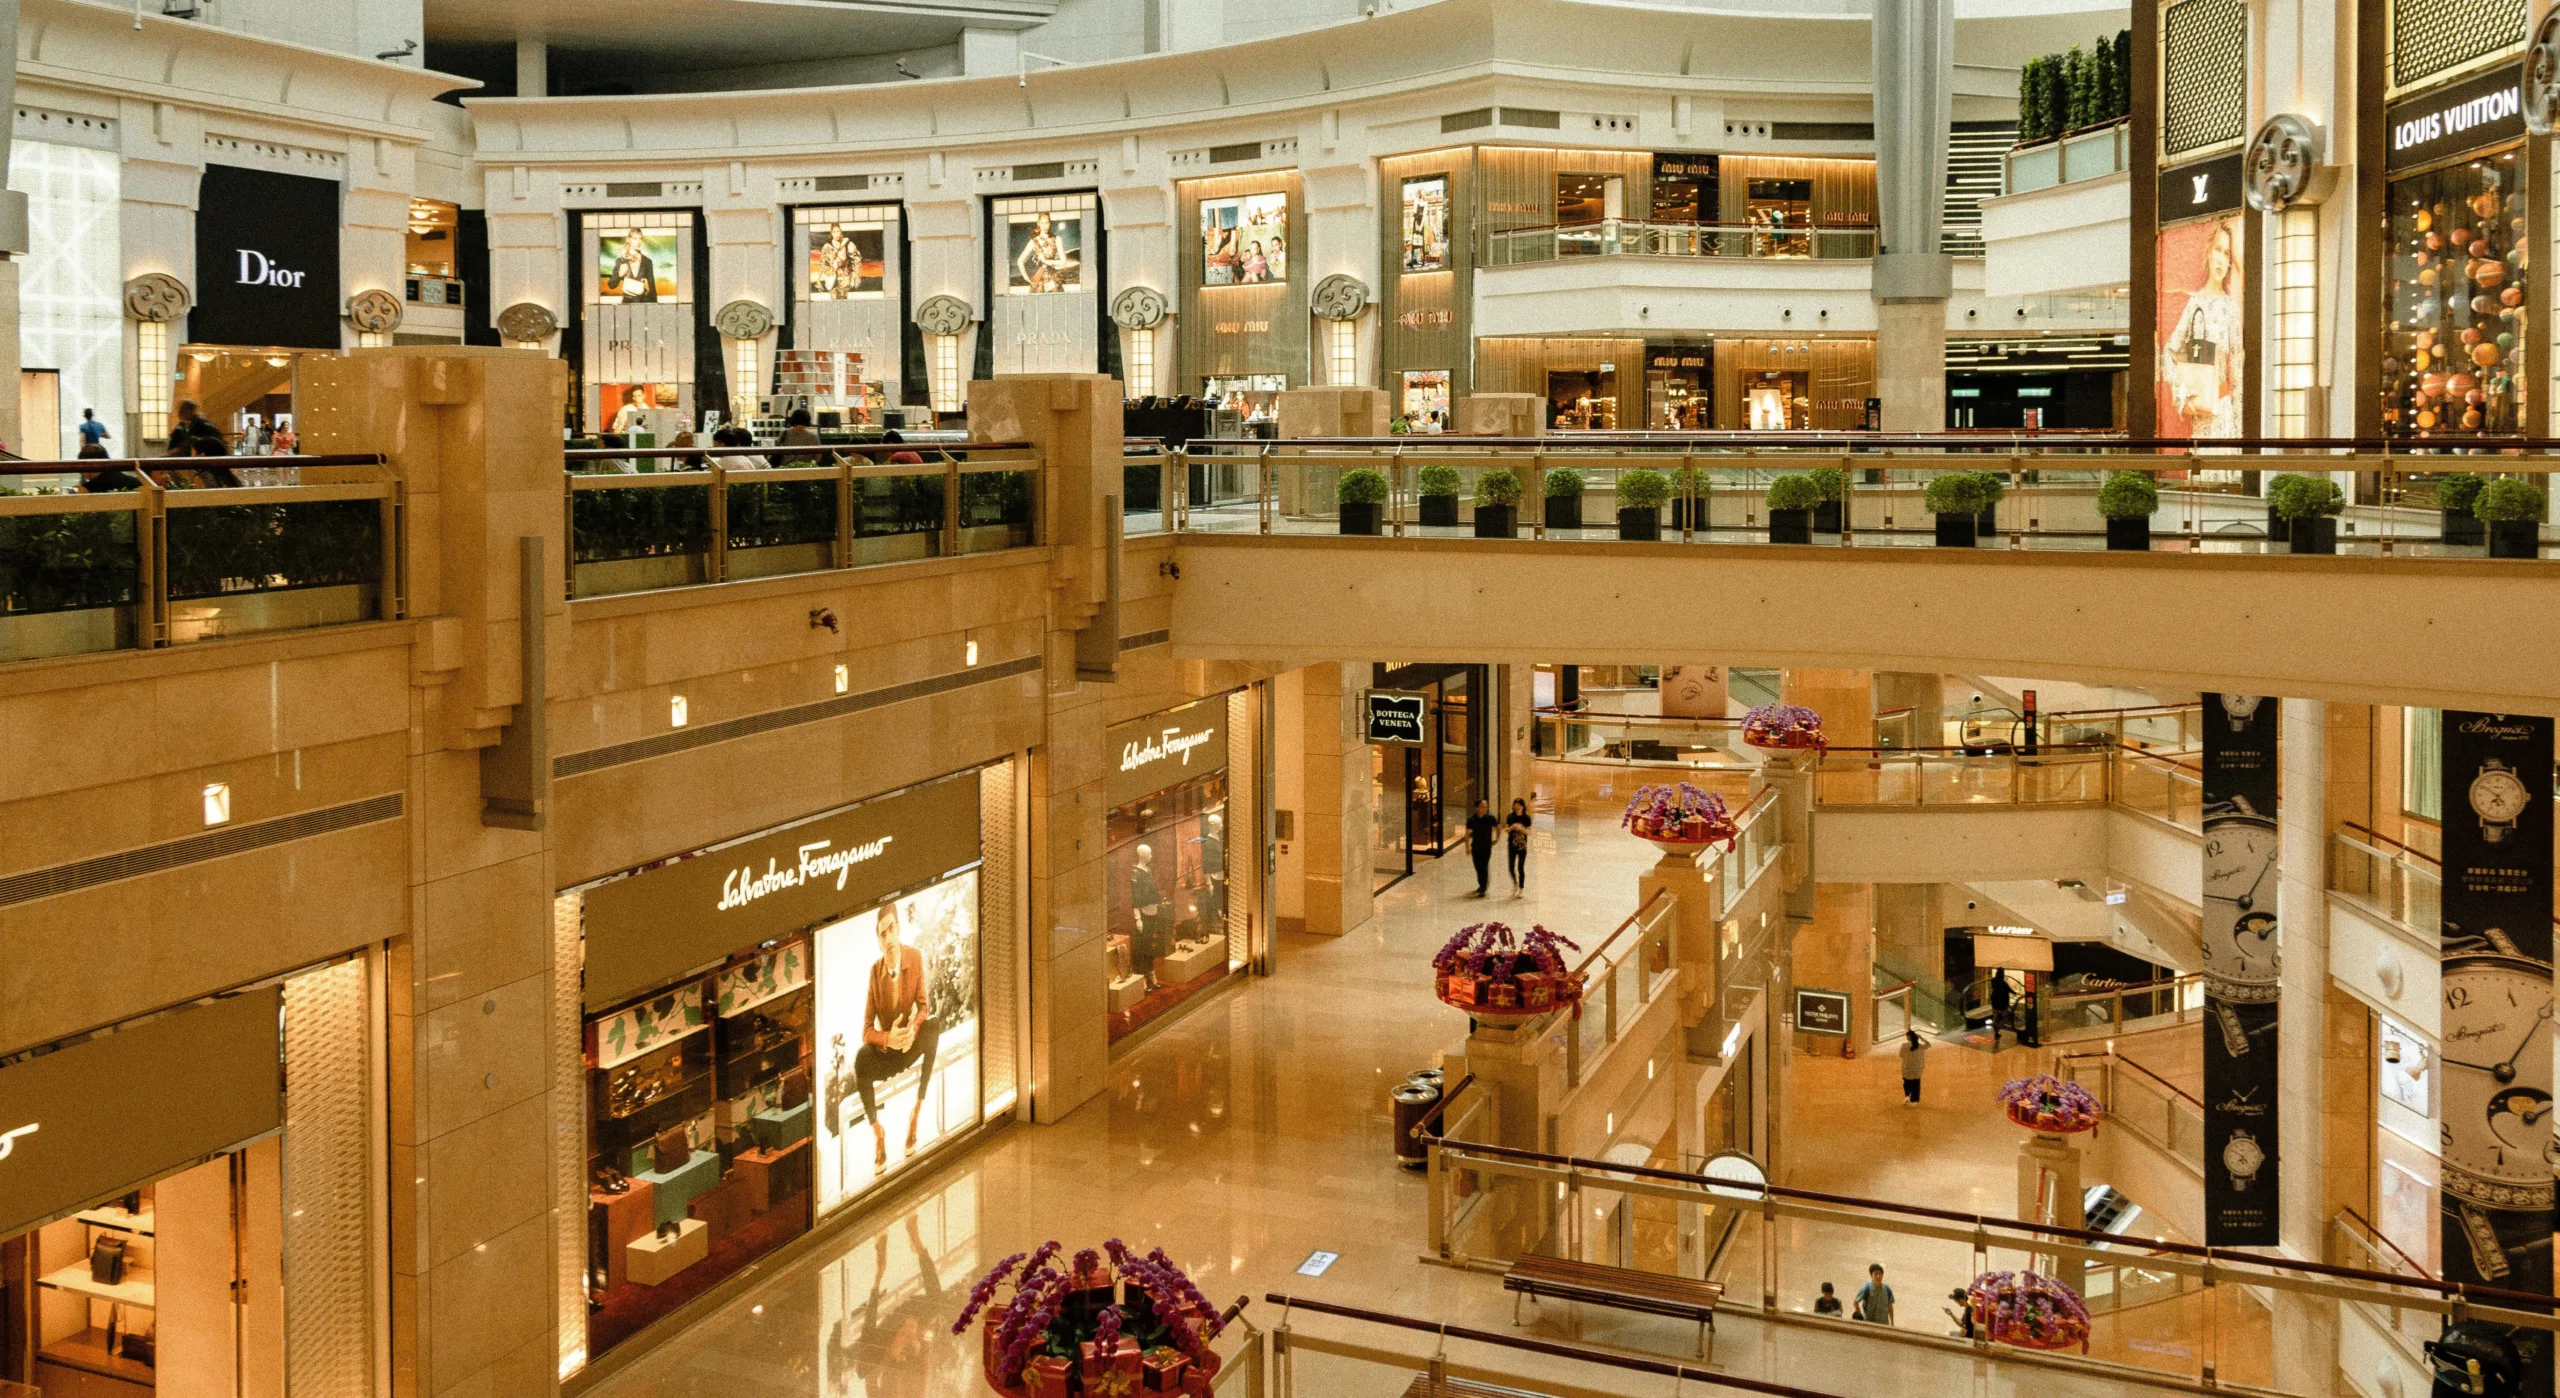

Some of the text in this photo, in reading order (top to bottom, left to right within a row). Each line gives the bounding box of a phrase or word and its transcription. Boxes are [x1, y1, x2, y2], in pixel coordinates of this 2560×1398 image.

[2394, 86, 2519, 151] LOUIS VUITTON
[1661, 163, 1709, 175] MIU MIU
[1823, 212, 1869, 223] MIU MIU
[235, 248, 306, 289] Dior
[1244, 320, 1269, 333] MIU
[1654, 356, 1678, 367] MIU
[1816, 400, 1864, 410] MIU MIU
[1376, 709, 1415, 719] BOTTEGA
[1379, 718, 1412, 728] VENETA
[2458, 716, 2535, 740] Breguet
[717, 835, 893, 911] Salvatore Ferragamo
